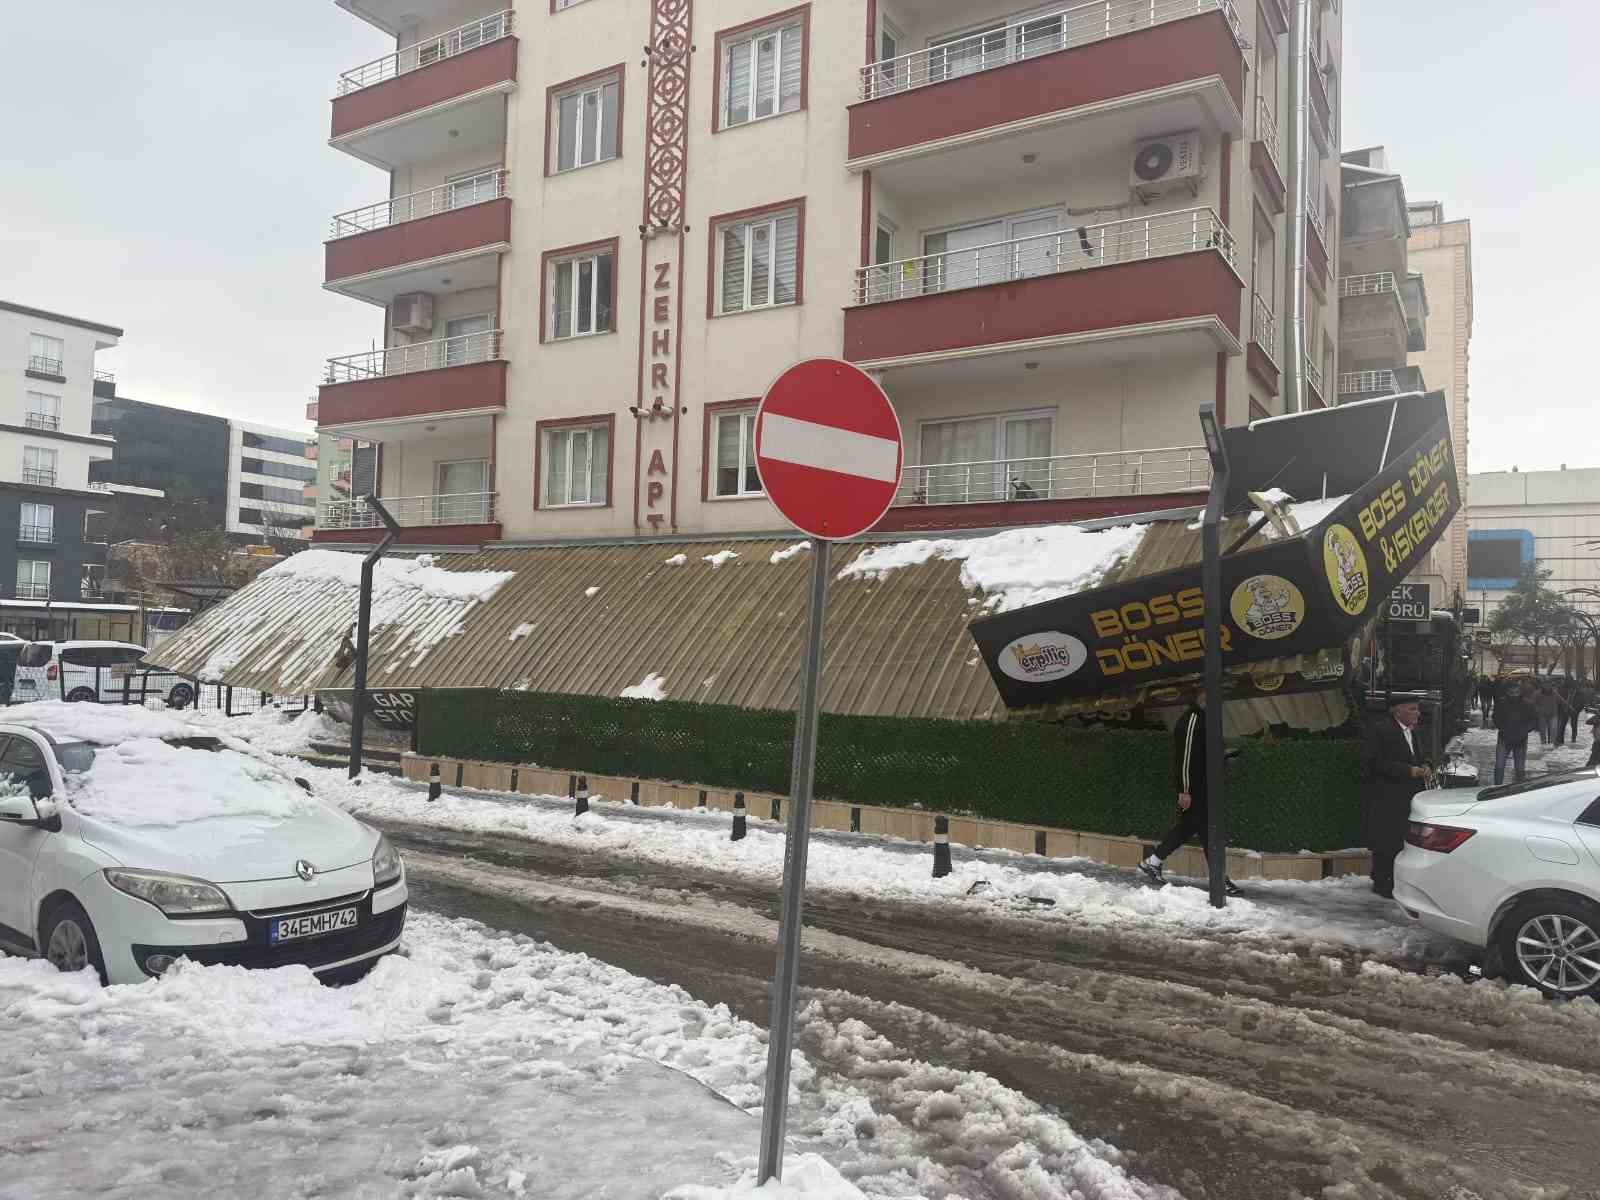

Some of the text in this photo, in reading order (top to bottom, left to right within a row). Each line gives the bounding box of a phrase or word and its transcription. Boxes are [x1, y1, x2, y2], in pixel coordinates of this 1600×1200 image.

[646, 262, 671, 530] ZEHRA APT
[1358, 438, 1449, 541] BOSS DÖNER
[1387, 585, 1414, 600] EK
[1389, 600, 1425, 618] ÖRÜ
[1090, 587, 1206, 638] BOSS
[1252, 612, 1292, 629] BOSS
[1095, 627, 1234, 676] DÖNER
[280, 909, 356, 938] 34EMH742
